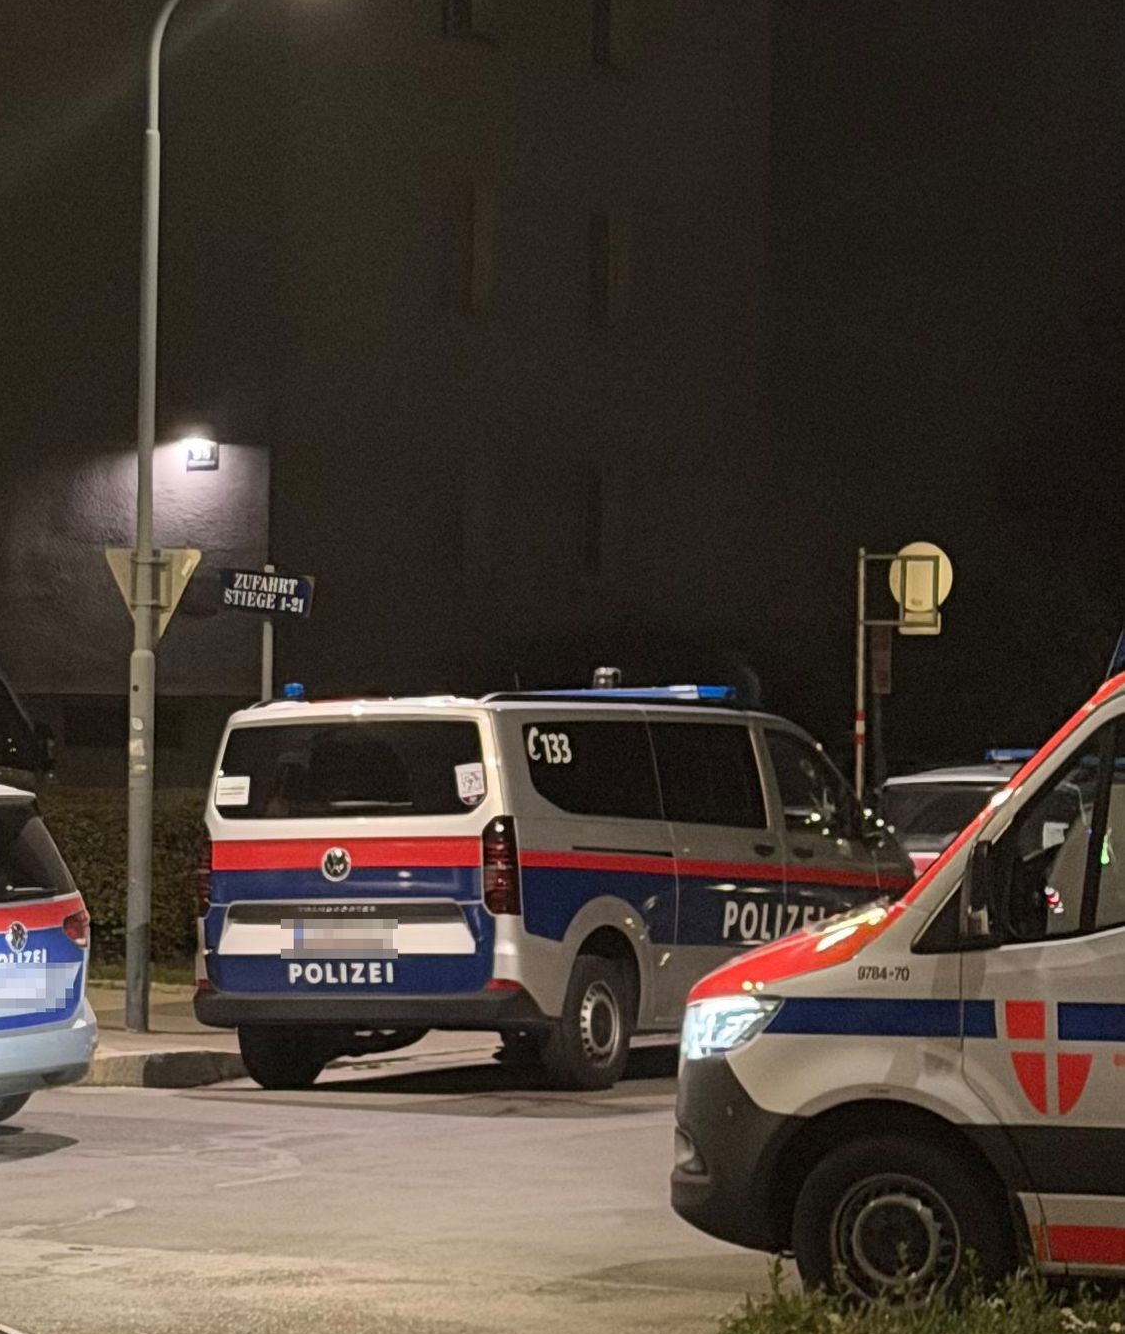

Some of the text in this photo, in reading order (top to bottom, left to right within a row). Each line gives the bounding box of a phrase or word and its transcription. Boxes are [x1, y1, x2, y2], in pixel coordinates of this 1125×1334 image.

[233, 573, 298, 595] ZUFAHRT
[223, 588, 277, 610] STIEGE
[539, 733, 572, 764] 133
[288, 962, 394, 984] POLIZEI
